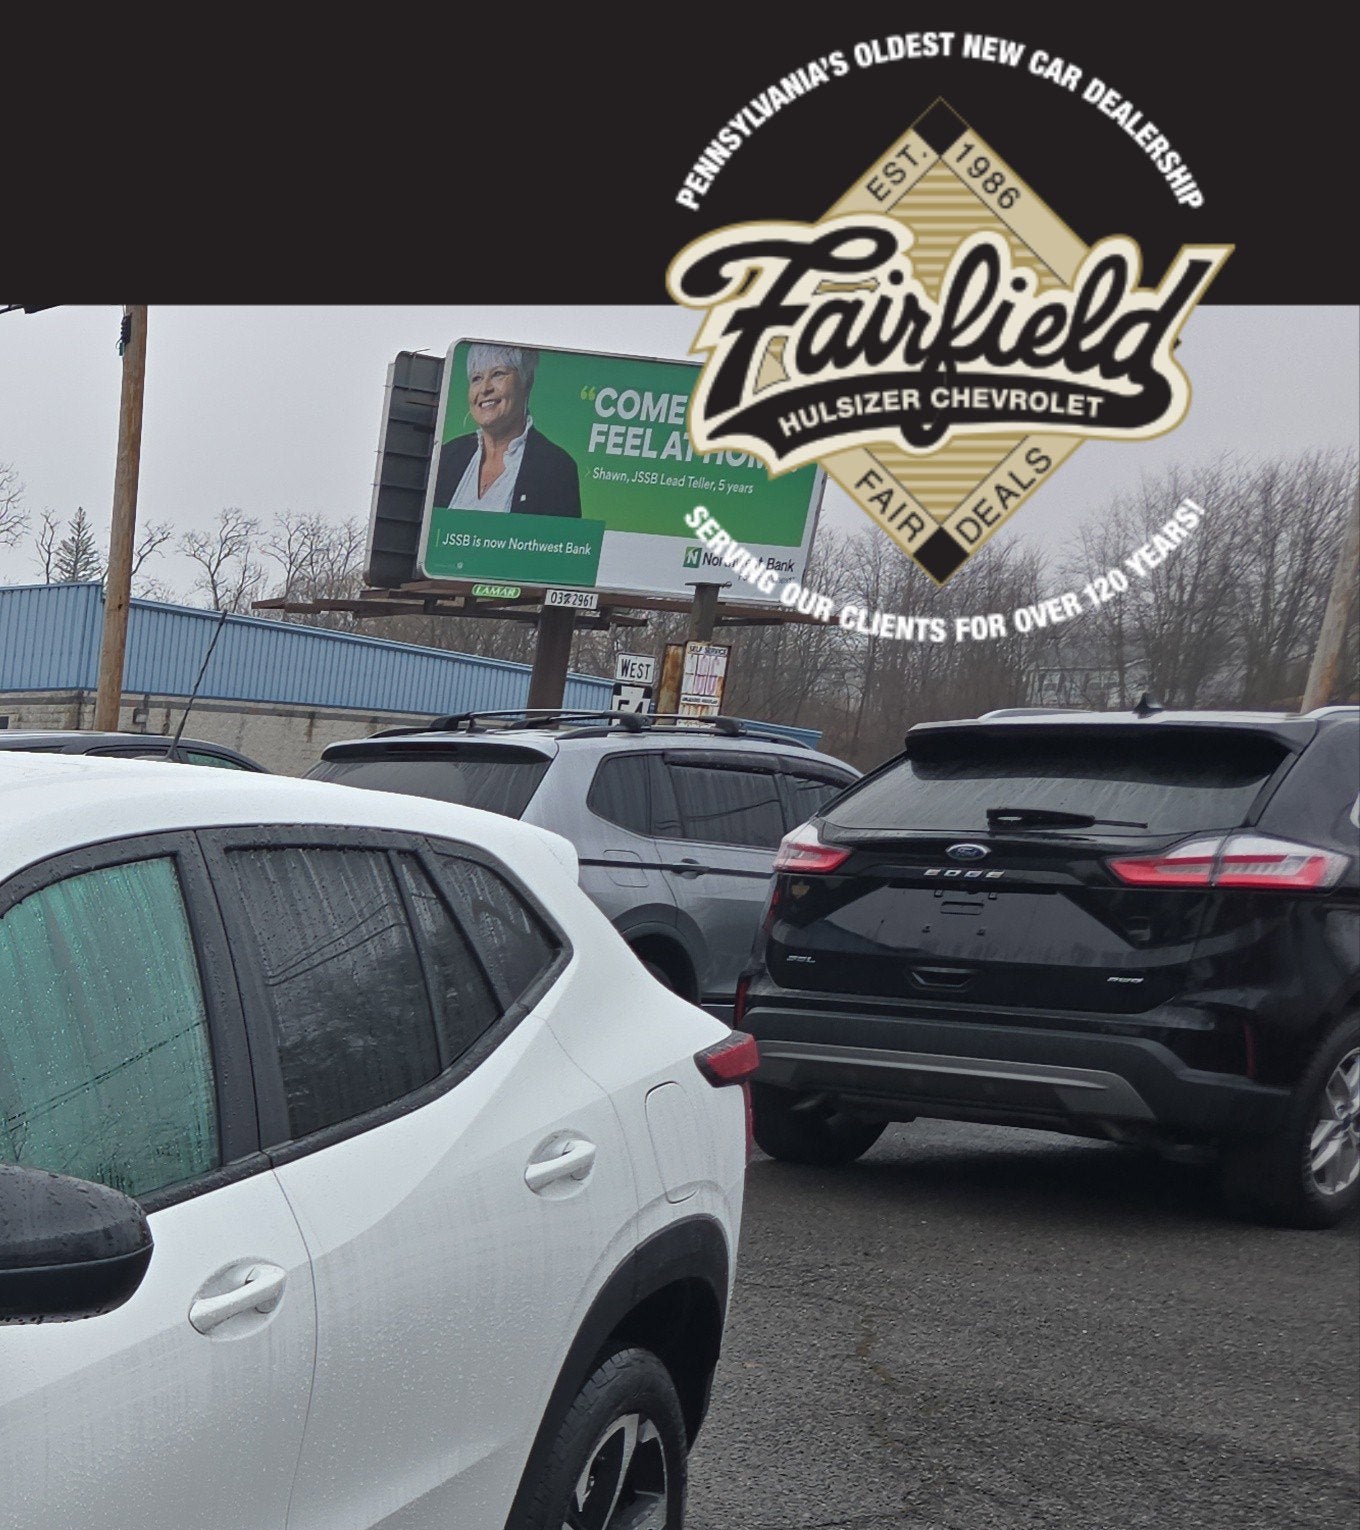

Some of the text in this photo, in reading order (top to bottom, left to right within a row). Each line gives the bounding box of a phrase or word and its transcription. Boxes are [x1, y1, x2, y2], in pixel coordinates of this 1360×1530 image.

[588, 423, 657, 459] FEEL
[592, 466, 754, 494] Shawn, JSSB Lead Teller, 5 years
[442, 533, 592, 555] JSSB is now Northwest Bank
[766, 557, 796, 572] Bank
[620, 658, 652, 680] WEST
